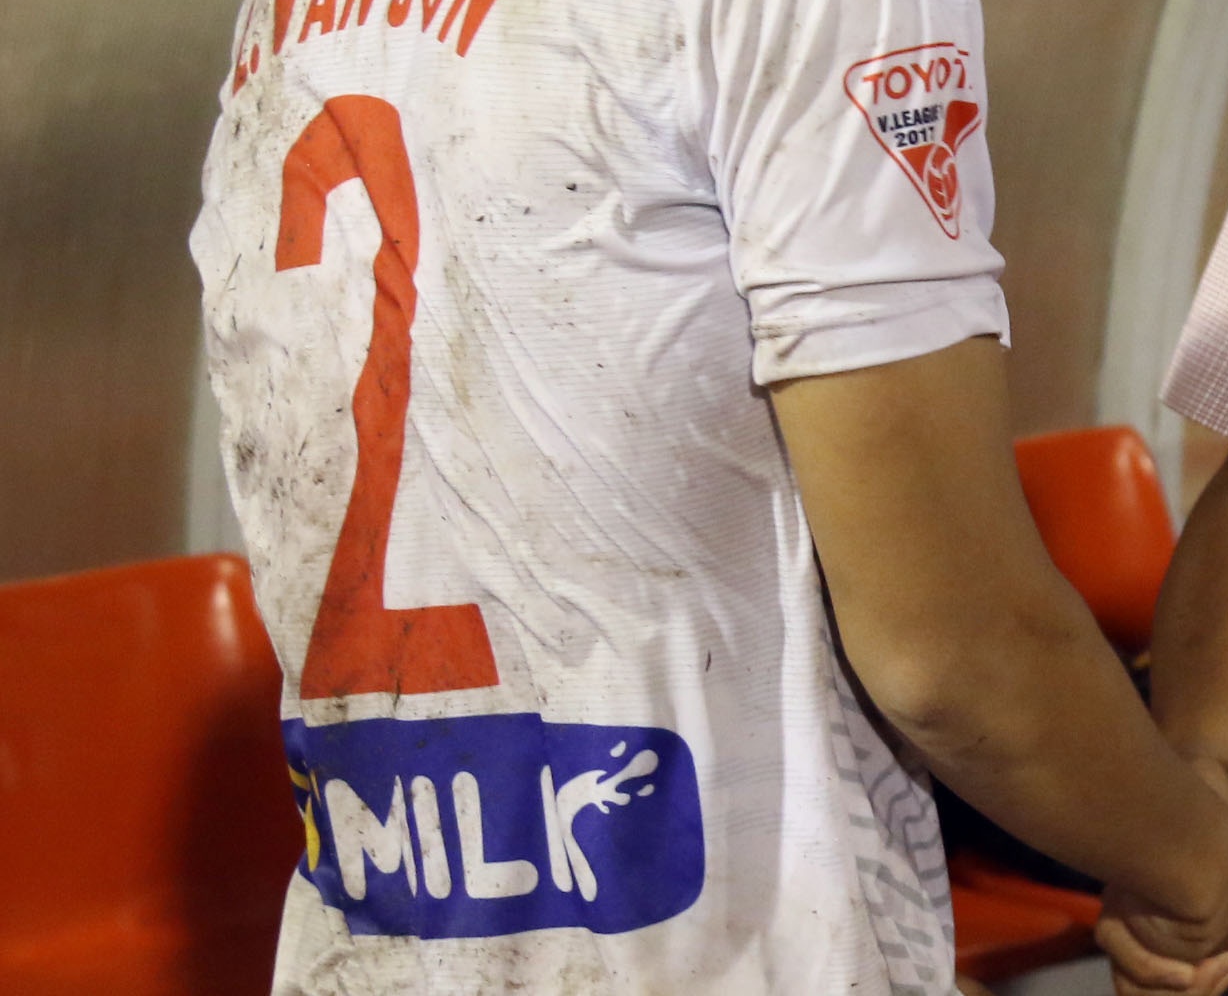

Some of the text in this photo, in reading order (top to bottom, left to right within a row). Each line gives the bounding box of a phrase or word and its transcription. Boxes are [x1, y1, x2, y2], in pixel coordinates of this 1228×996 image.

[863, 57, 974, 104] TOYOT
[275, 94, 500, 700] 2
[324, 741, 659, 902] MILK
